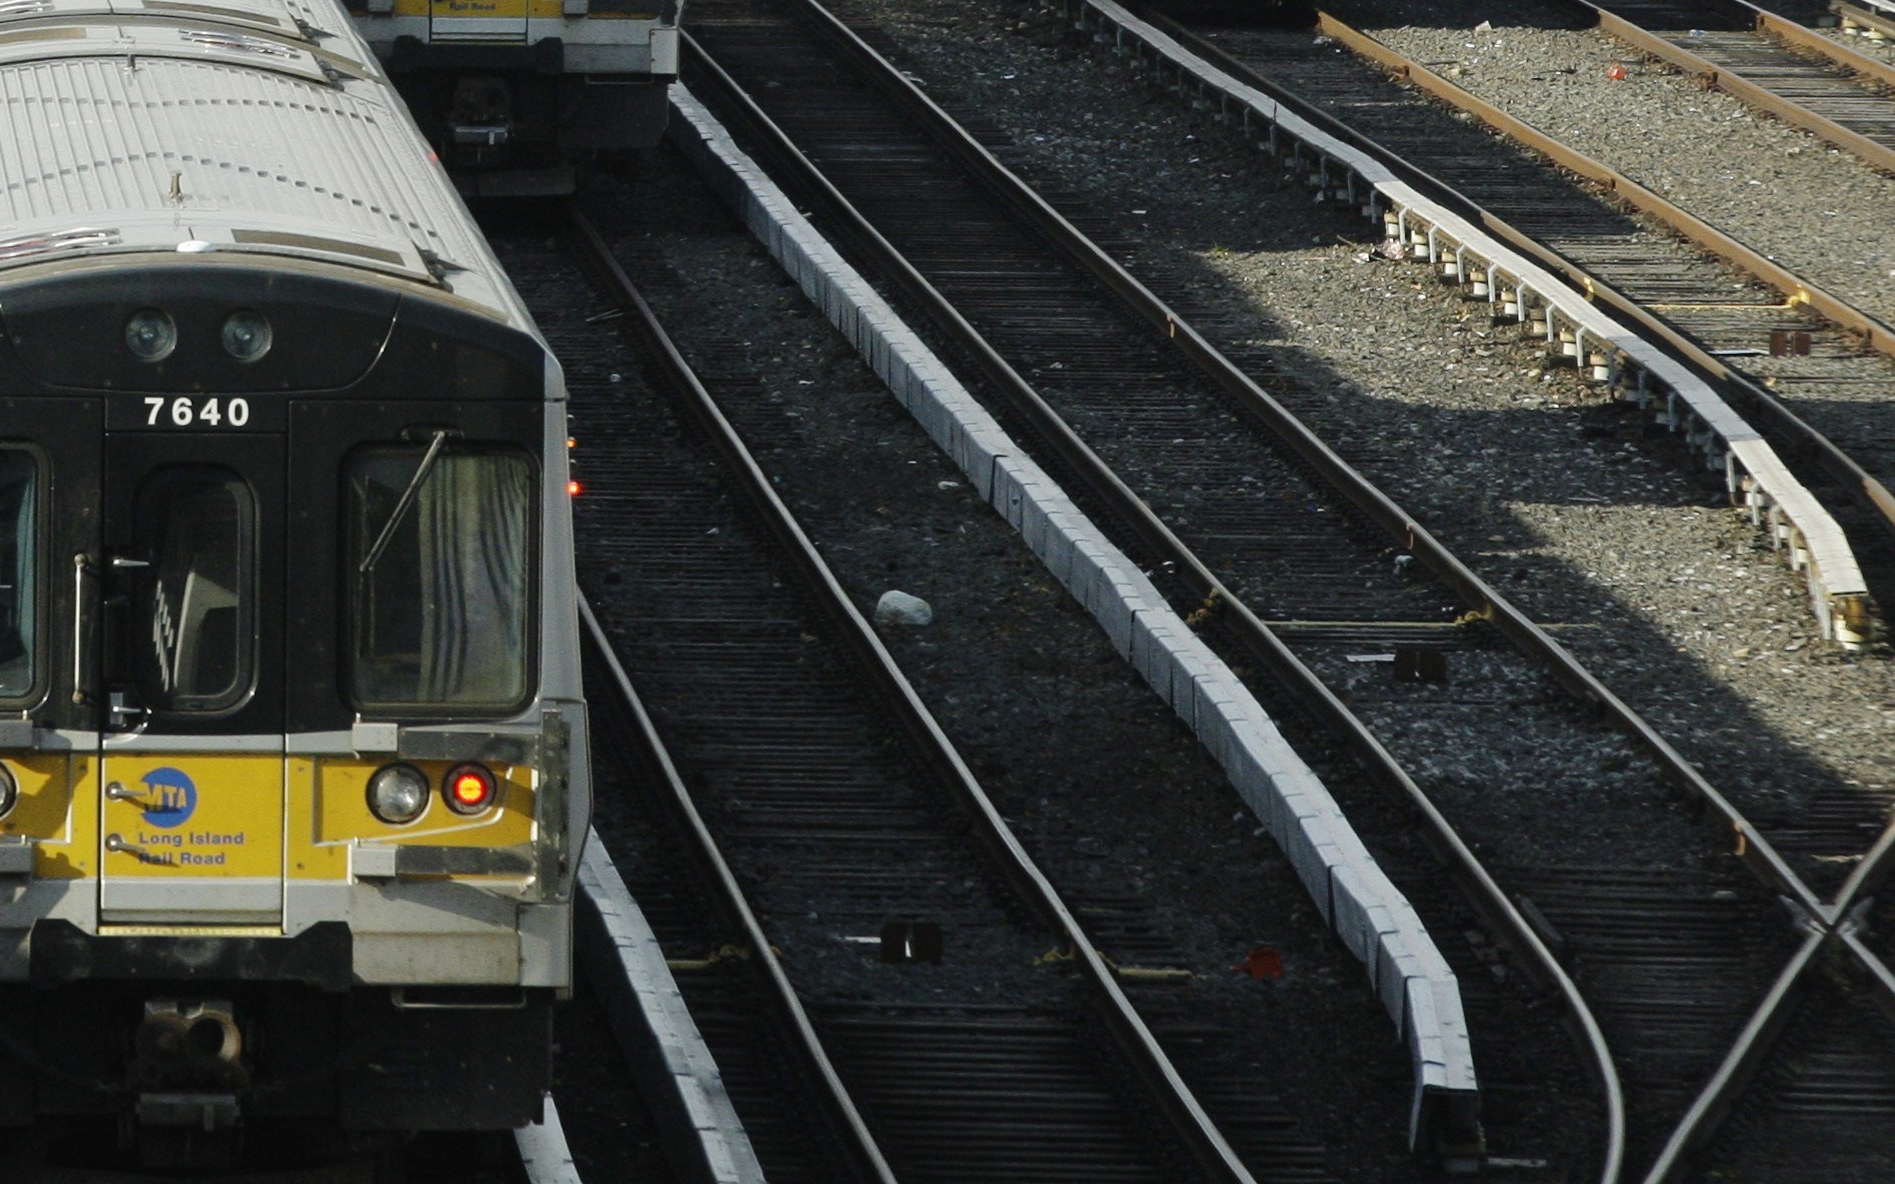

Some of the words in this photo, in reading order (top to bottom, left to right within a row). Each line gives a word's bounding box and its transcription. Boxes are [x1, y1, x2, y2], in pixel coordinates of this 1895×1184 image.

[144, 397, 249, 426] 7640
[139, 832, 183, 847] Long
[189, 832, 245, 845] Island
[180, 852, 226, 865] Road
